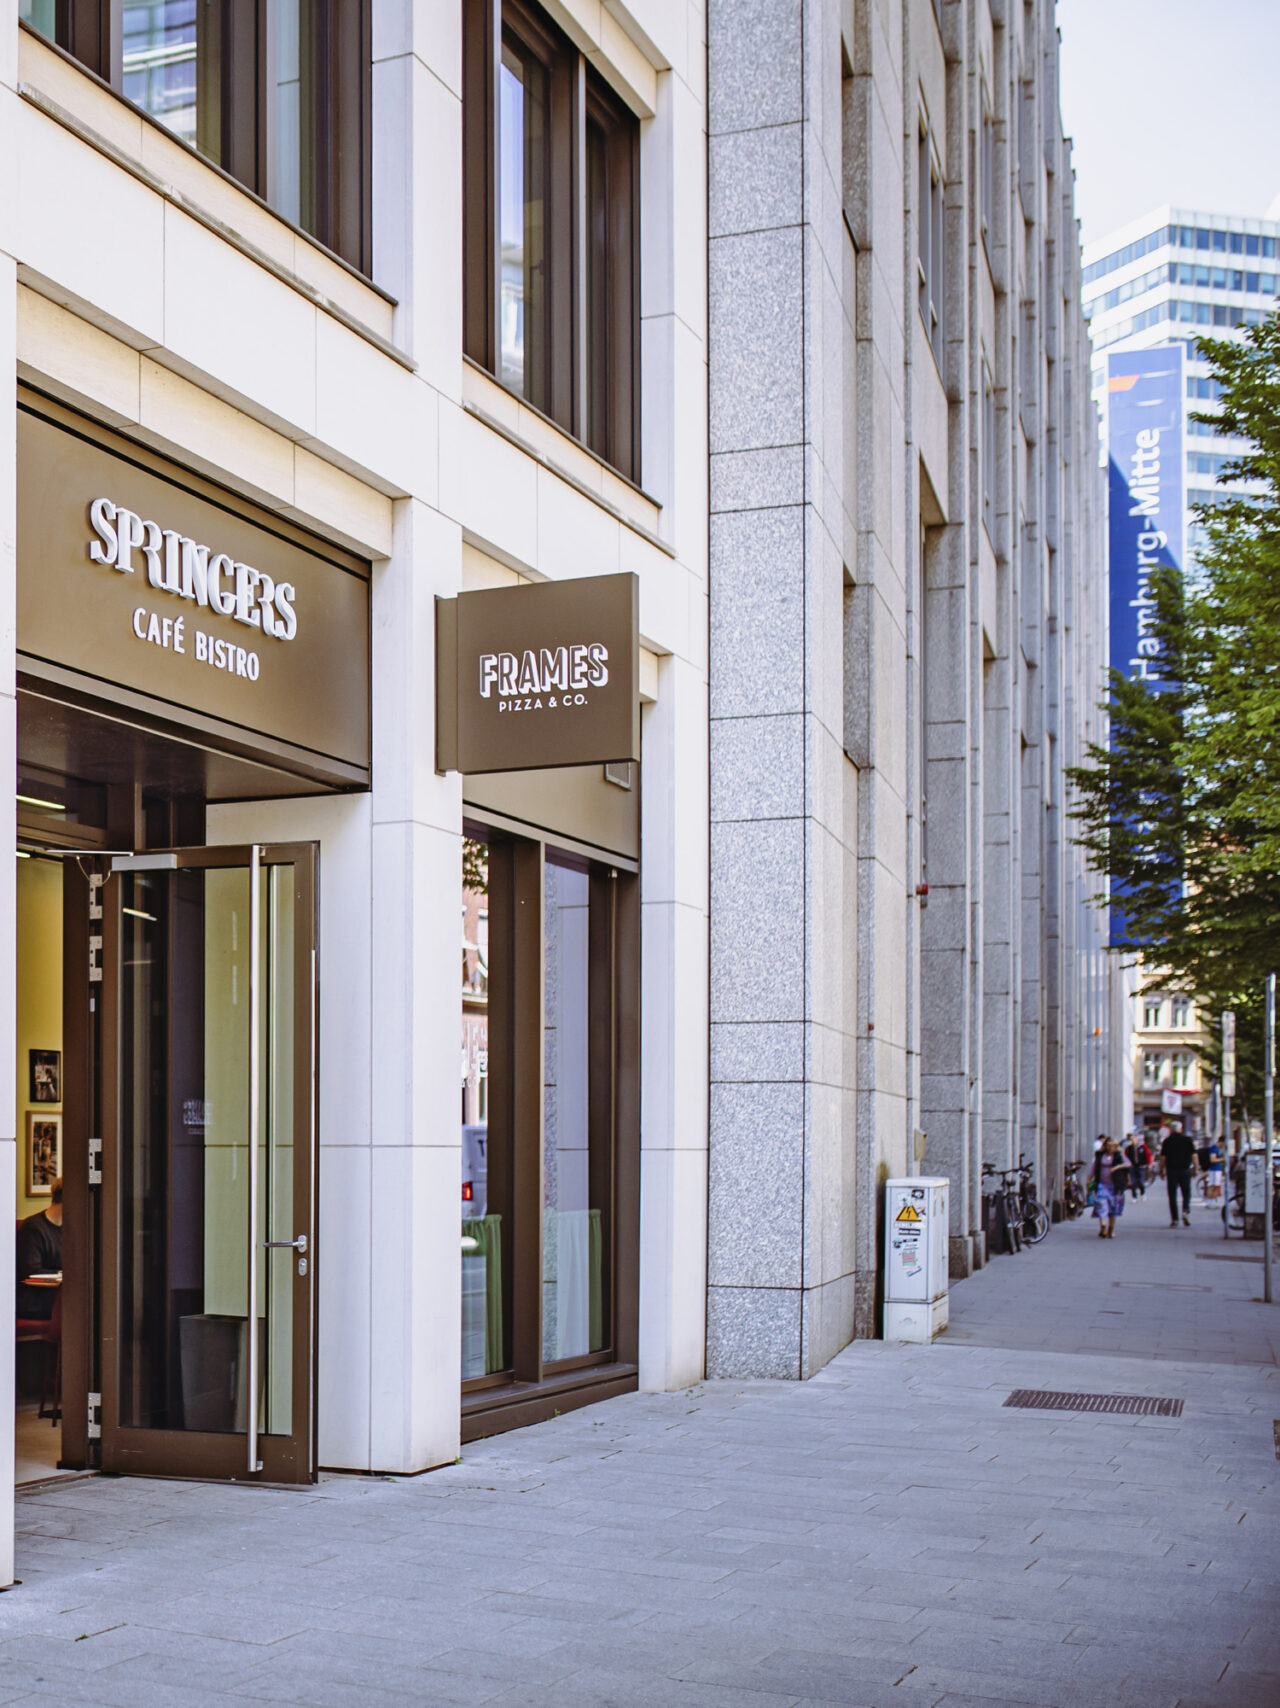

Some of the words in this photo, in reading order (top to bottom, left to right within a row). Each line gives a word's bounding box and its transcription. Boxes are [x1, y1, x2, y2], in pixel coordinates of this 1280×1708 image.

[89, 497, 298, 641] SPRINGERS
[133, 607, 185, 653] CAFÉ
[195, 631, 260, 681] BISTRO
[479, 643, 609, 698] FRAMES
[499, 698, 543, 712] PIZZA
[549, 697, 557, 708] &
[563, 694, 588, 706] CO.
